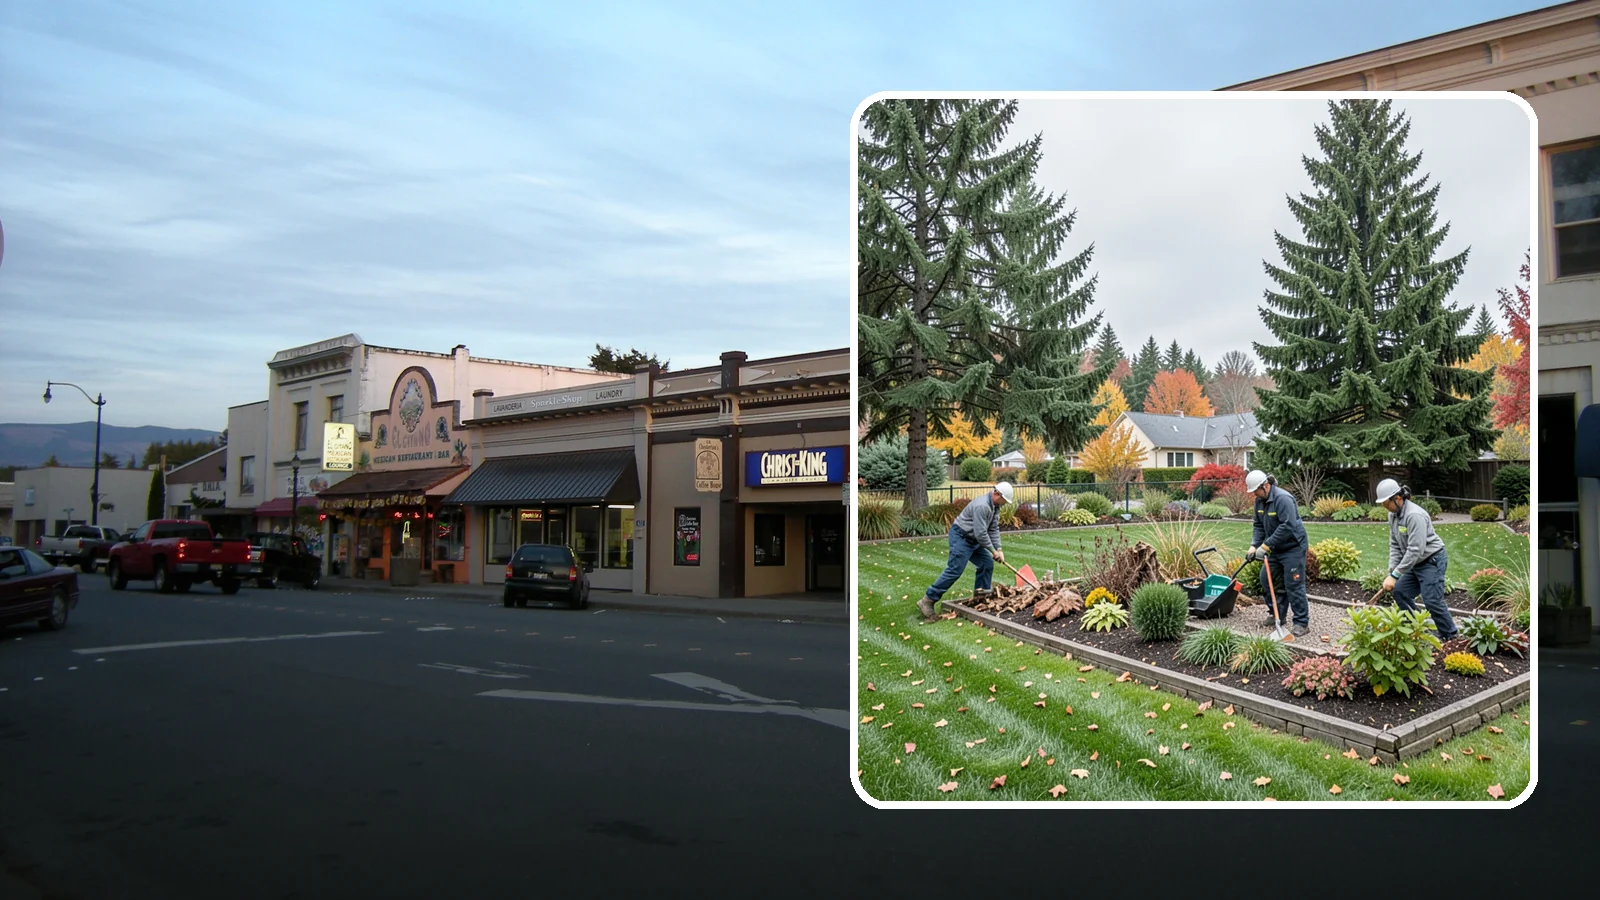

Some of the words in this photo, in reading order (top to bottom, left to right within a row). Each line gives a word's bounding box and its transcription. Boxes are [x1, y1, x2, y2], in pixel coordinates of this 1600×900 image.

[595, 389, 624, 400] LAUNDRY
[493, 401, 523, 413] LAVANDERIA
[530, 397, 561, 409] Sparkle
[562, 394, 583, 405] Shop
[373, 454, 396, 464] MEXICAN
[397, 451, 434, 462] RESTAURANT
[438, 450, 450, 459] BAR
[760, 452, 797, 478] CHRIST
[799, 450, 827, 476] KING
[696, 480, 709, 488] Coffee
